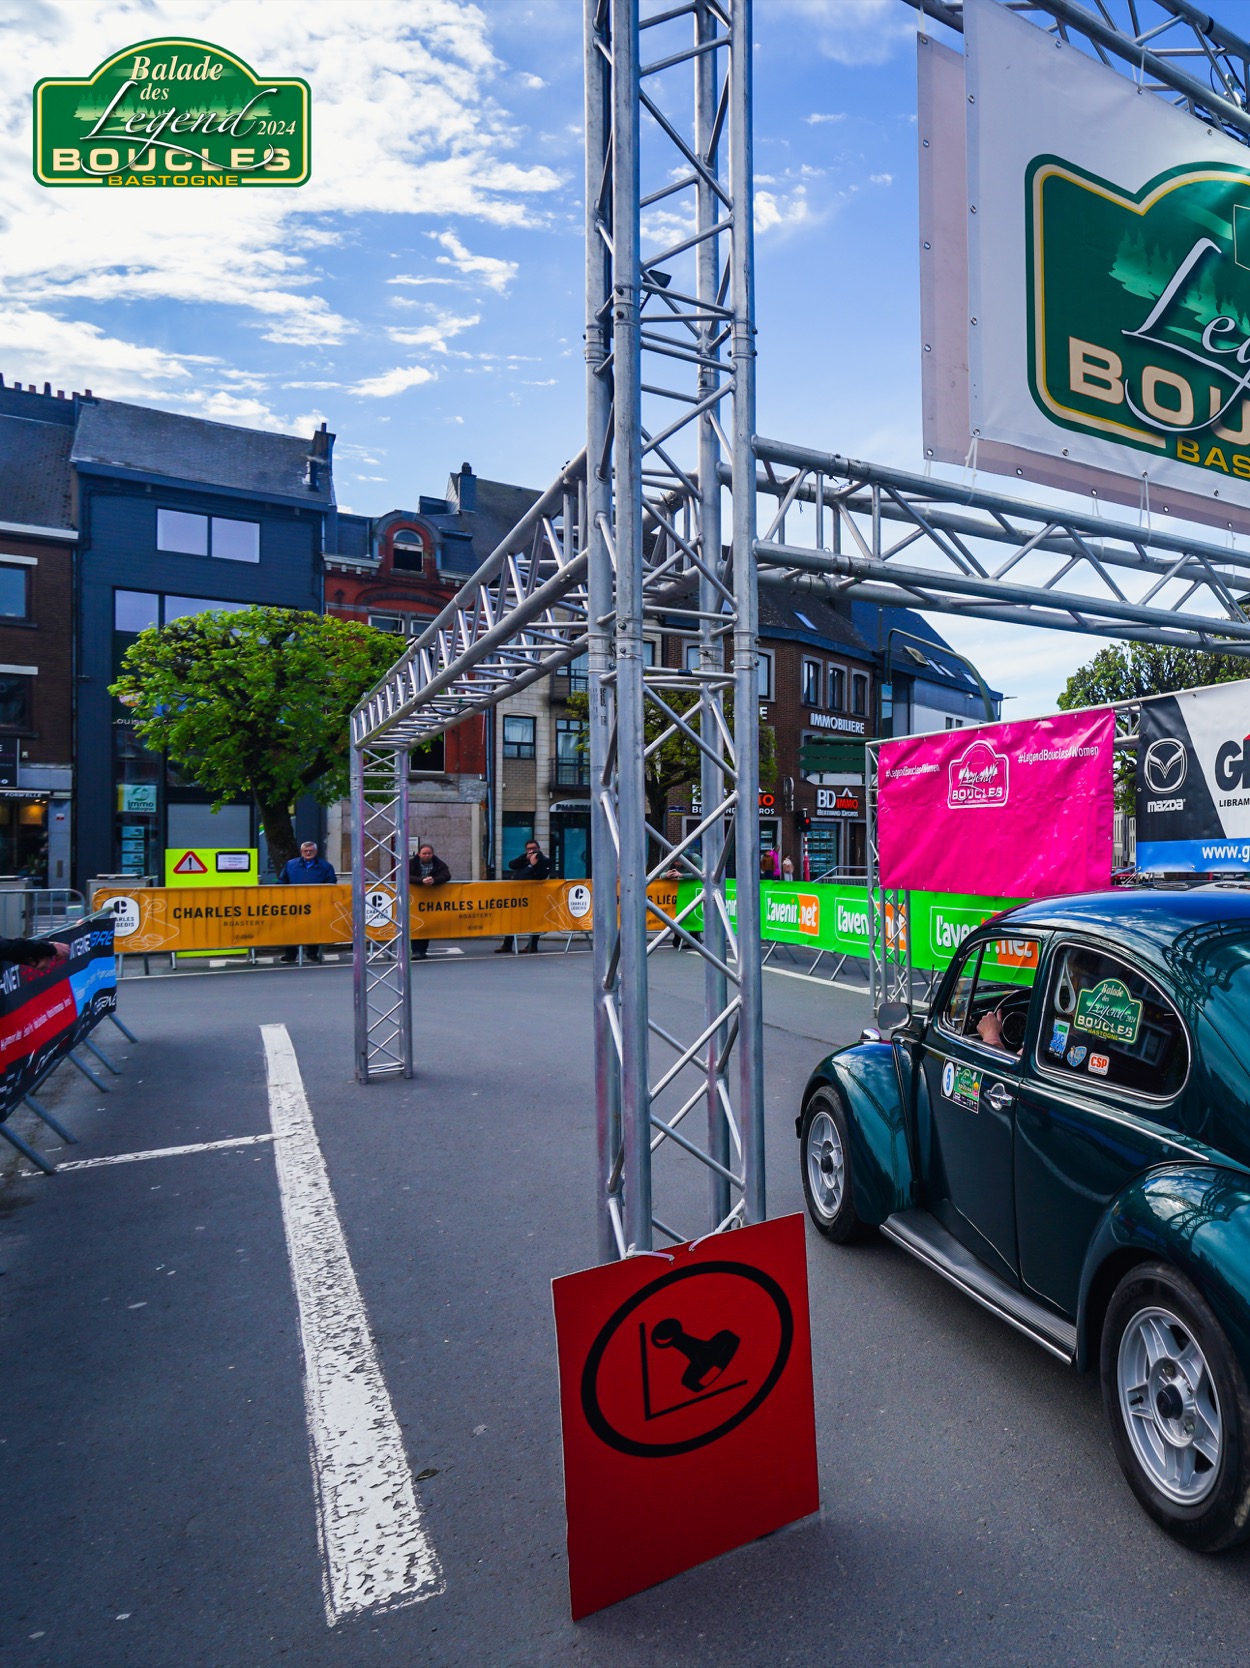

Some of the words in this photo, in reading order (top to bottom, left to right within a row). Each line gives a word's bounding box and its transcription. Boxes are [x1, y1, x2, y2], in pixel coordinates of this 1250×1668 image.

[810, 712, 865, 735] IMMOBILIERE
[816, 789, 836, 809] BD
[836, 798, 859, 810] IMMO
[952, 787, 1003, 801] BOUCLES
[173, 906, 242, 919] CHARLES
[247, 904, 312, 917] LIÉGEOIS
[418, 900, 474, 912] CHARLES
[478, 897, 529, 910] LIÉGEOIS
[1086, 992, 1135, 1021] Legend
[1078, 1015, 1133, 1037] BOUCLES
[1090, 1056, 1107, 1068] CSP
